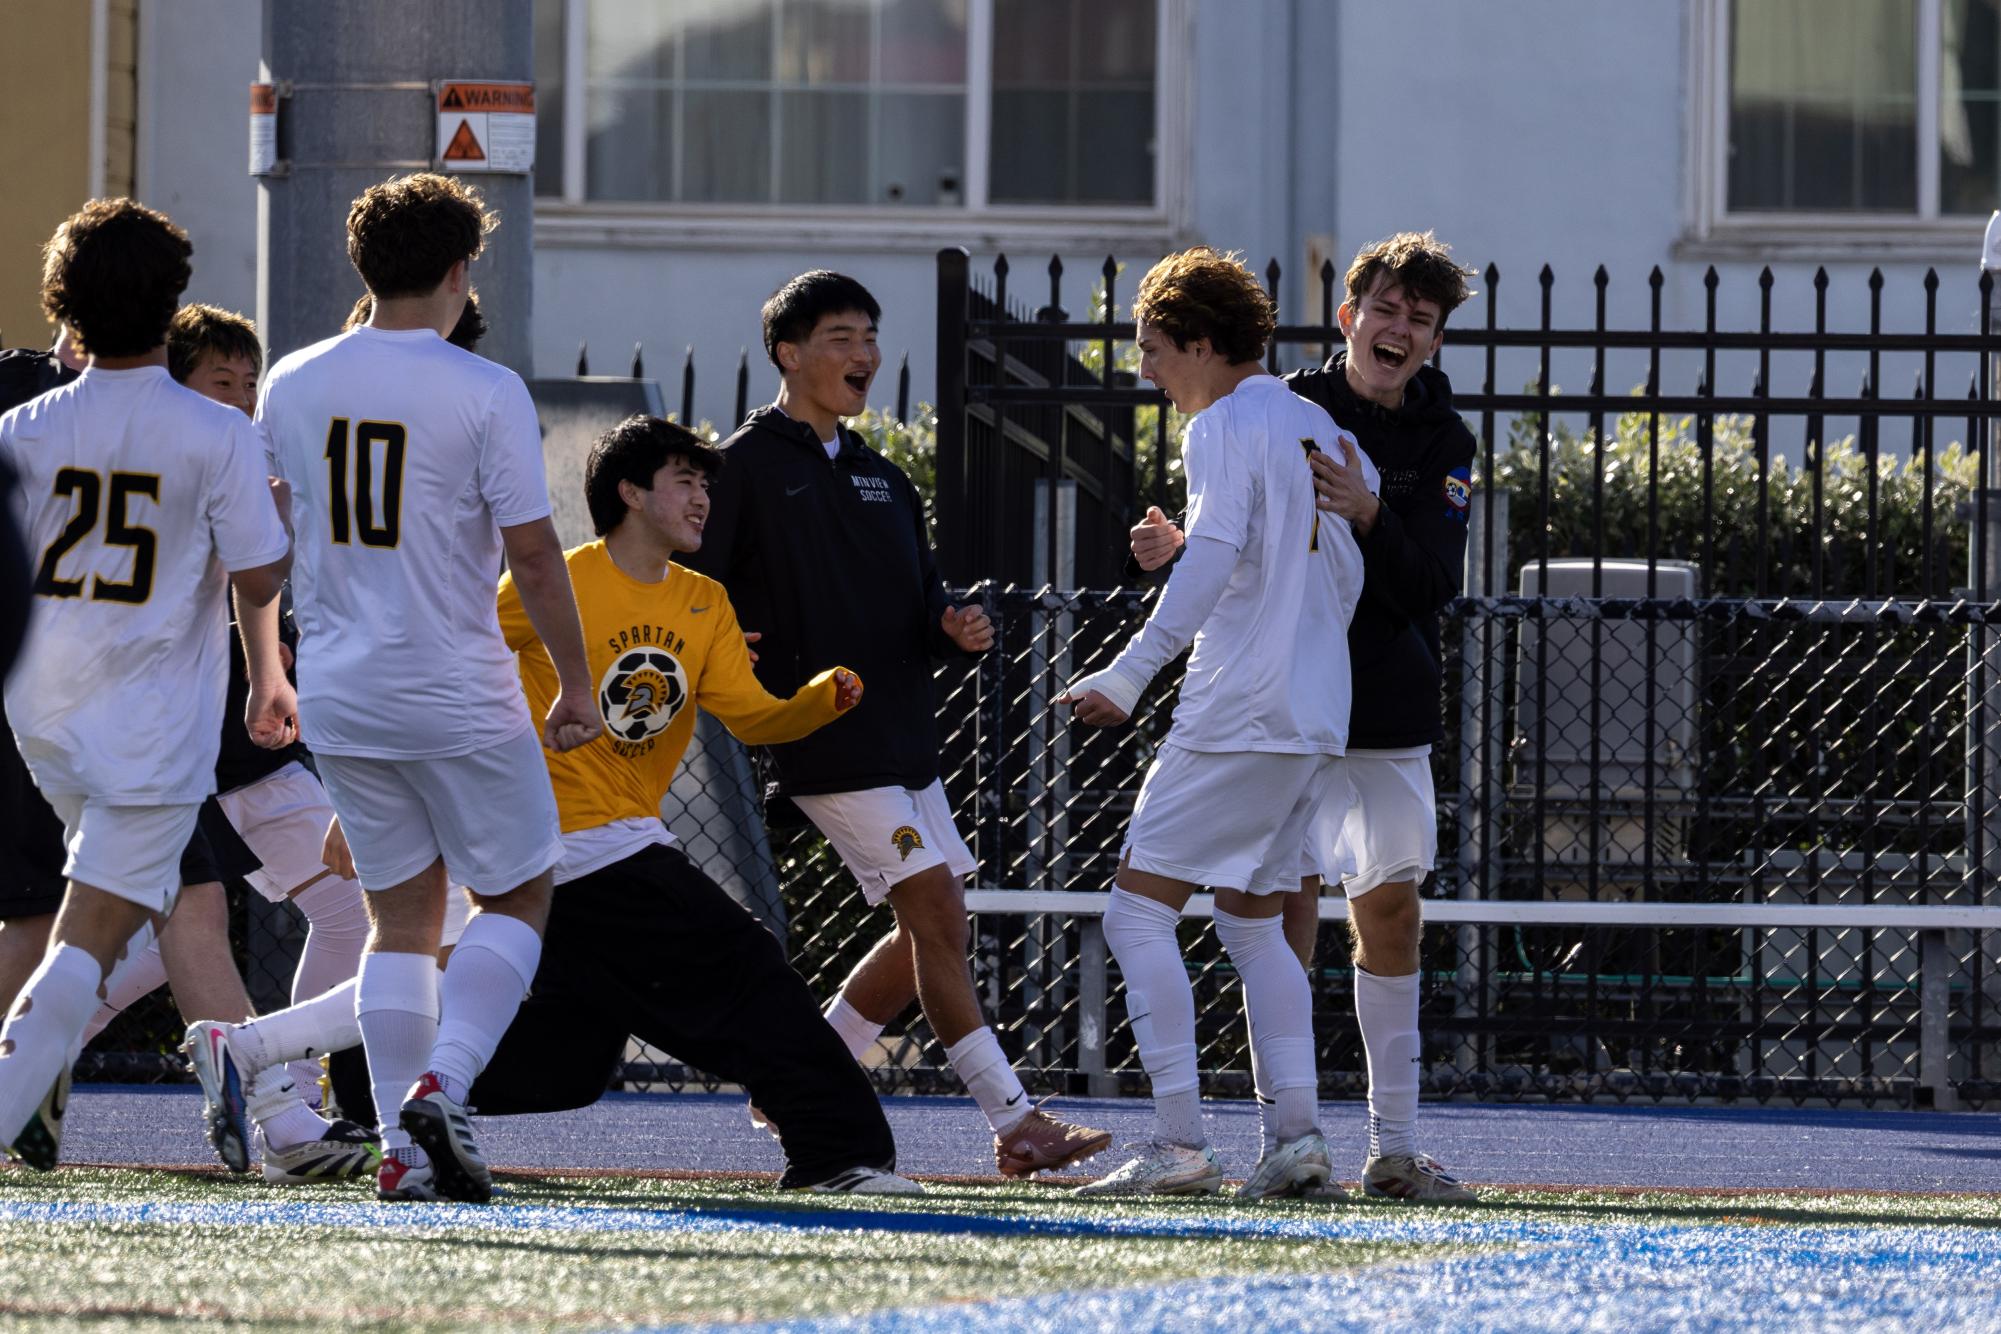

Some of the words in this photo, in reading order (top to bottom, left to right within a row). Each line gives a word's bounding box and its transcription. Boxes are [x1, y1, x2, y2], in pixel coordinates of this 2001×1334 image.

[465, 89, 534, 106] WARNING
[323, 416, 408, 550] 10
[851, 475, 870, 488] MTN
[868, 477, 889, 489] VIEW
[860, 489, 892, 502] SOCCER
[33, 466, 161, 607] 25
[608, 625, 686, 655] SPARTAN
